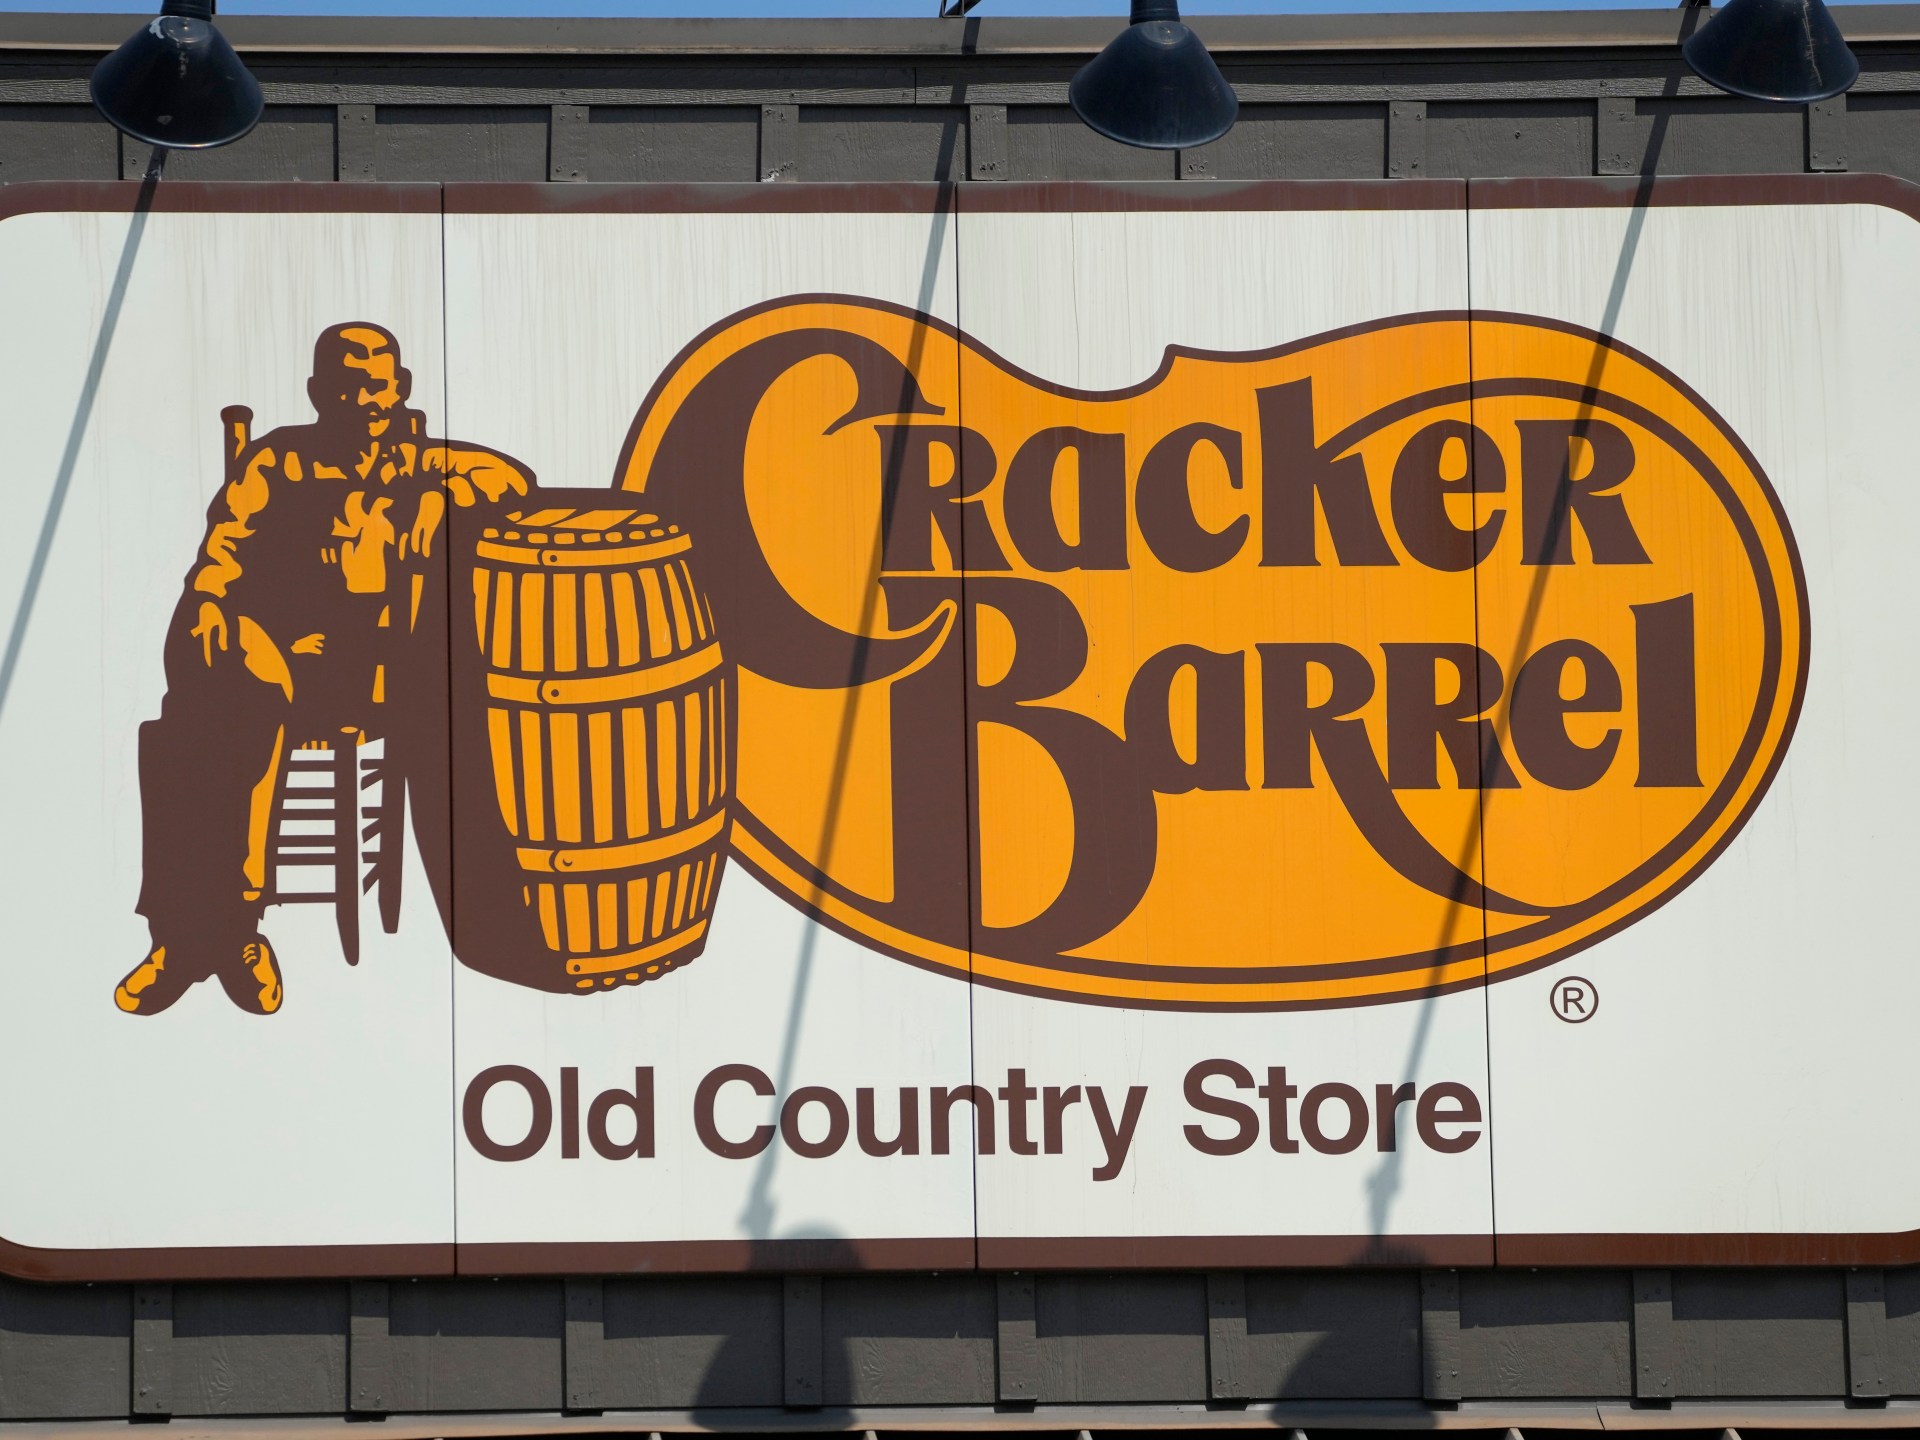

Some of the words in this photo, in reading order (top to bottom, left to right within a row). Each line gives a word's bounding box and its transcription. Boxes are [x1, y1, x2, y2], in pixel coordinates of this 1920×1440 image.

[463, 1064, 655, 1162] Old
[693, 1063, 1148, 1182] Country
[1183, 1058, 1482, 1156] Store
